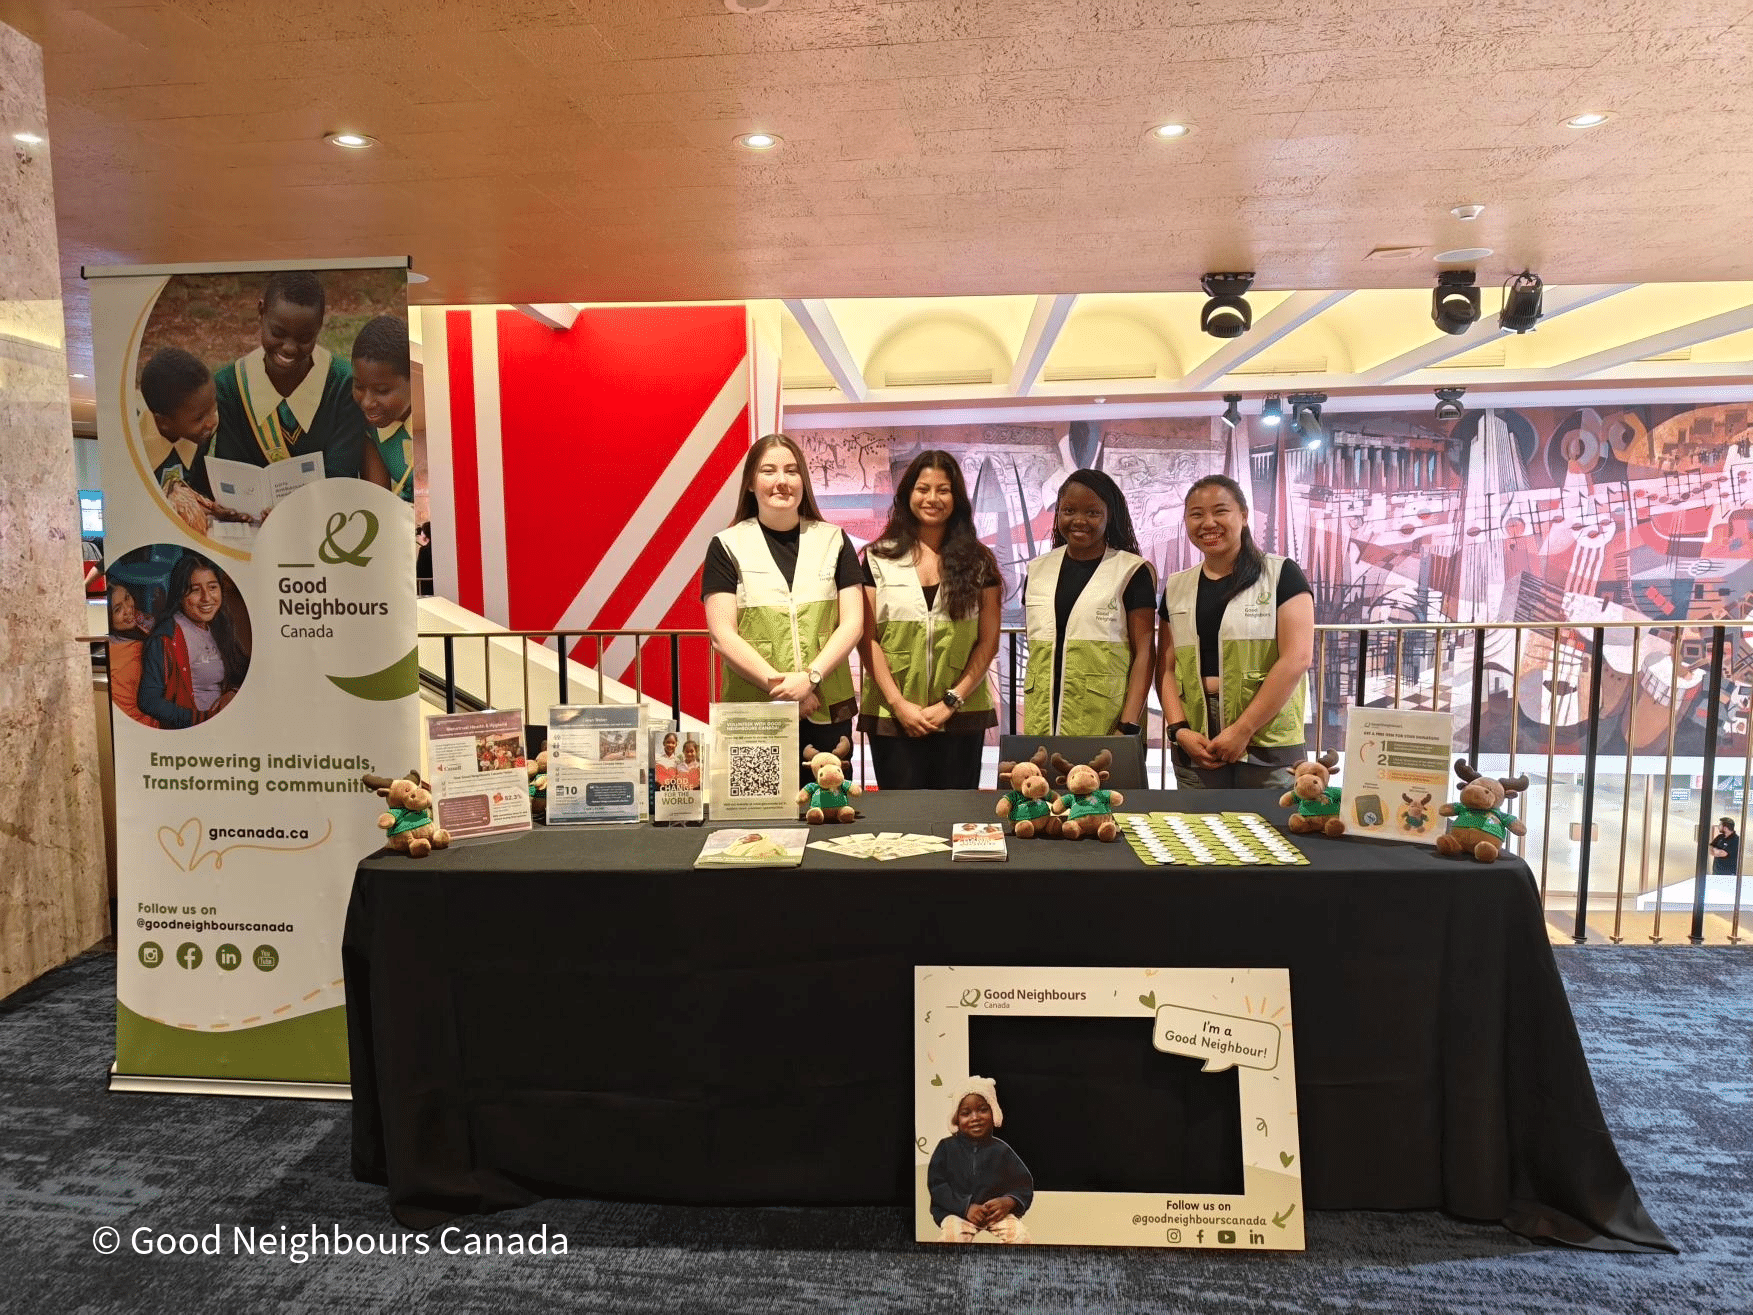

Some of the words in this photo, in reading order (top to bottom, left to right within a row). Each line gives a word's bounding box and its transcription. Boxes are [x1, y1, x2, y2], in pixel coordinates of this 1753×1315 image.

[278, 576, 327, 594] Good
[278, 597, 389, 620] Neighbours
[280, 623, 334, 638] Canada
[1380, 740, 1386, 752] 1
[150, 752, 261, 773] Empowering
[267, 754, 376, 773] individuals,
[1377, 753, 1387, 766] 2
[143, 775, 259, 796] Transforming
[265, 777, 375, 794] communiti
[664, 777, 689, 785] GOOD
[565, 786, 578, 795] 10
[661, 796, 695, 805] WORLD
[208, 826, 310, 841] gncanada.ca
[138, 902, 178, 914] Follow
[182, 905, 197, 915] us
[200, 905, 217, 916] on
[136, 917, 294, 933] @goodneighbourscanada
[983, 988, 1015, 1000] Good
[1016, 989, 1087, 1003] Neighbours
[983, 1001, 1011, 1009] Canada
[1202, 1020, 1220, 1035] I'm
[1224, 1028, 1233, 1037] a
[1165, 1030, 1197, 1046] Good
[1201, 1036, 1268, 1059] Neighbour!
[1166, 1199, 1200, 1211] Follow
[1202, 1203, 1215, 1211] us
[1218, 1203, 1231, 1211] on
[1131, 1212, 1268, 1227] @goodneighbourscanada
